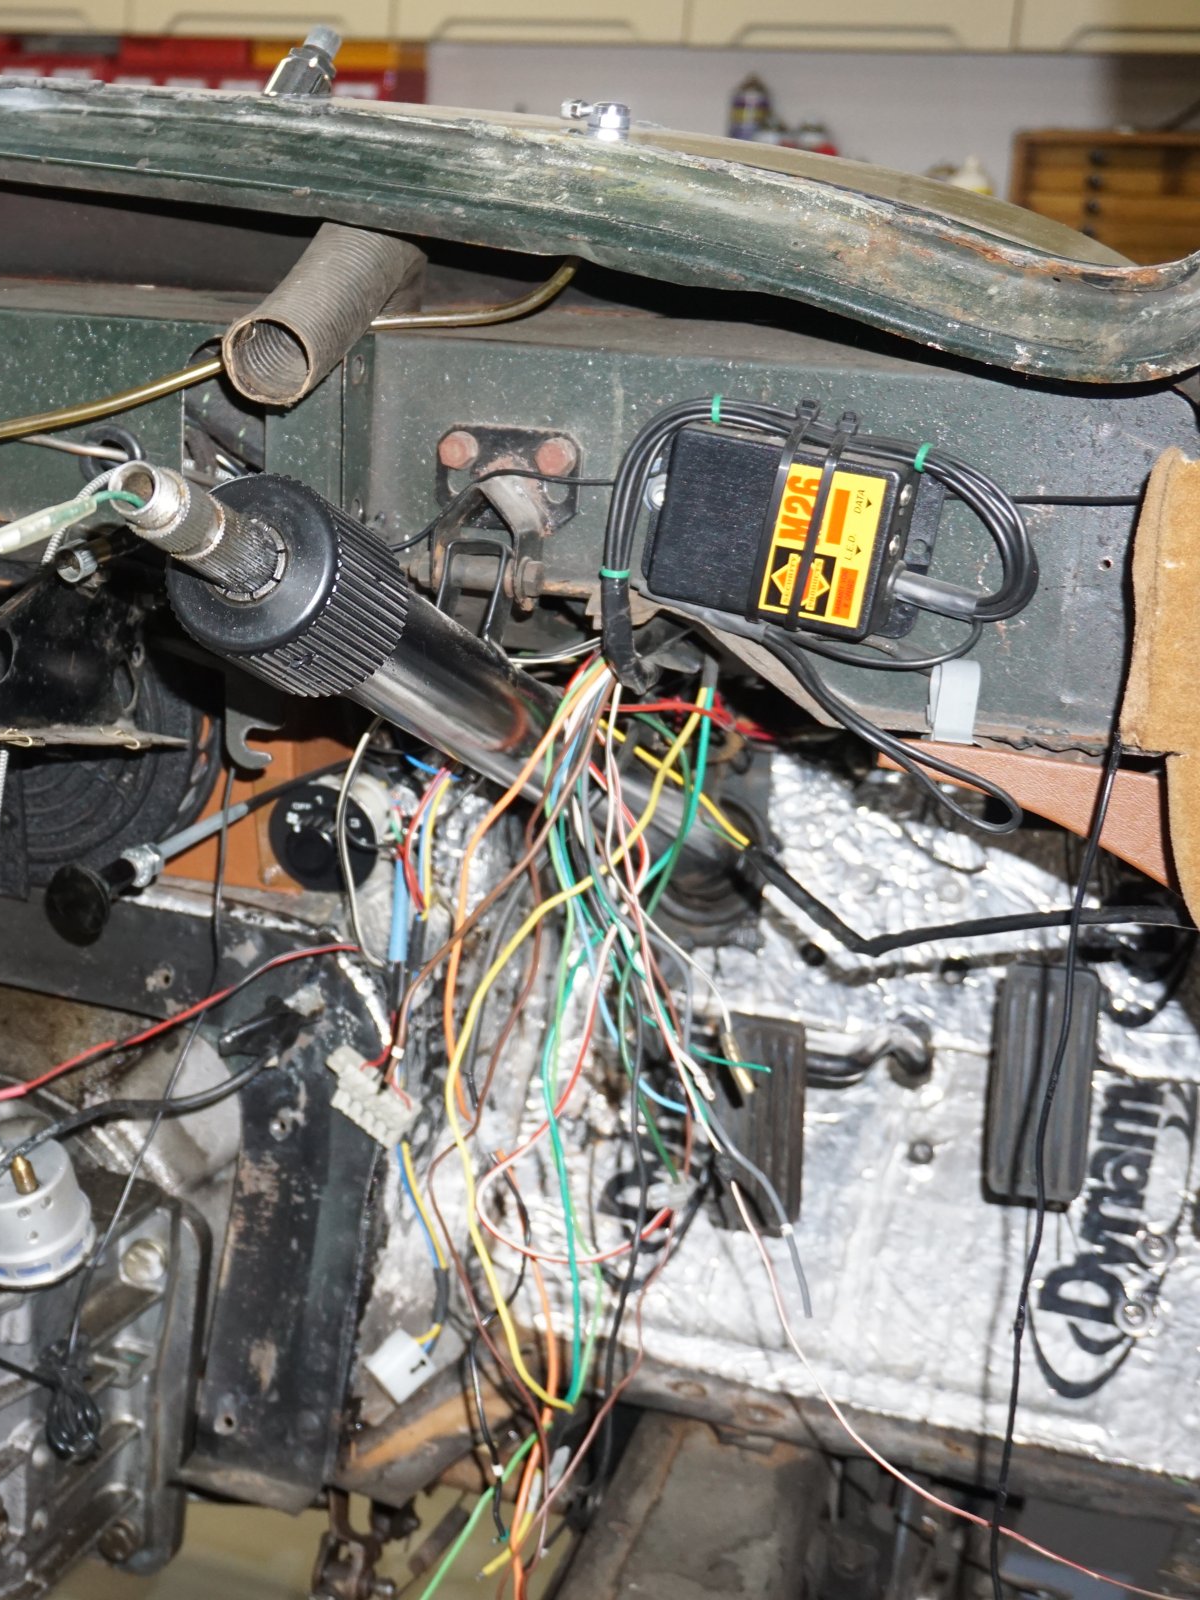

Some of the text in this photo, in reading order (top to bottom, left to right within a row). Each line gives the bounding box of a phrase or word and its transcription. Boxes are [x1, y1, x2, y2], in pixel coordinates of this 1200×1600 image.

[777, 475, 822, 546] M26
[853, 488, 866, 514] DATA
[784, 556, 797, 603] SECURITY
[808, 560, 824, 608] PRODUCTS
[1038, 1082, 1166, 1326] Dynam
